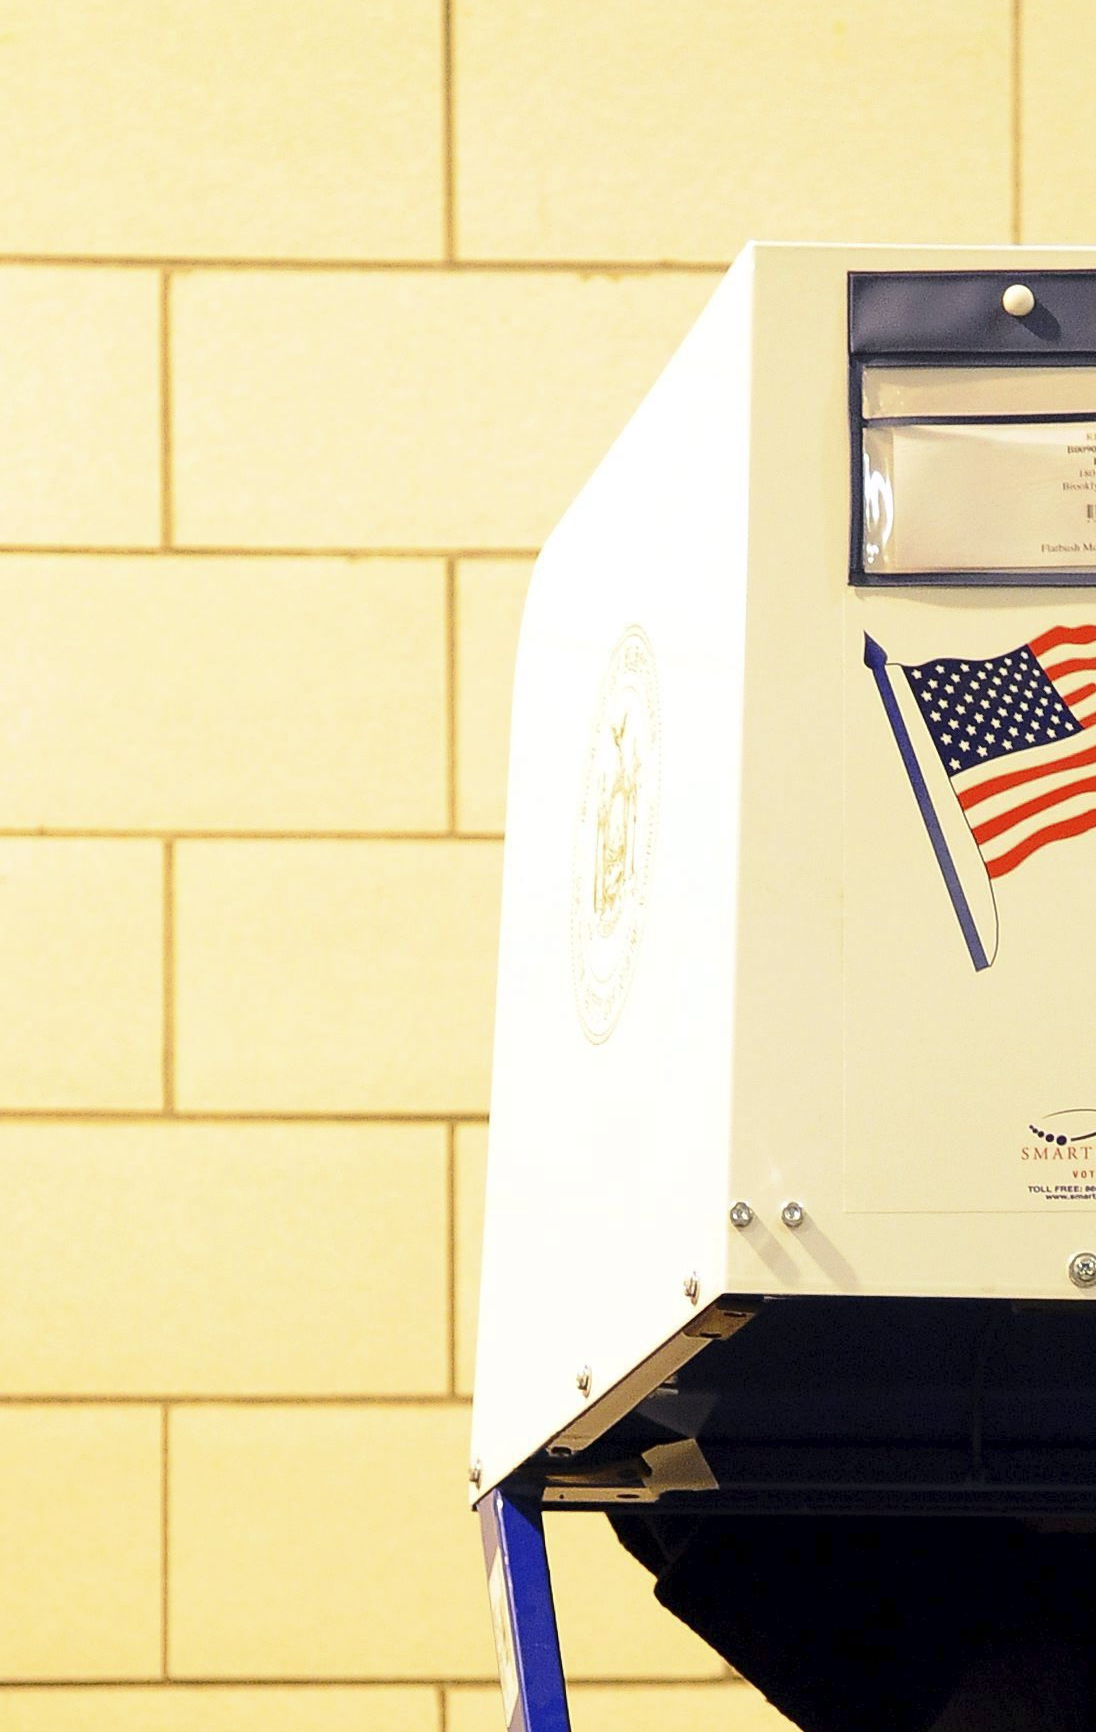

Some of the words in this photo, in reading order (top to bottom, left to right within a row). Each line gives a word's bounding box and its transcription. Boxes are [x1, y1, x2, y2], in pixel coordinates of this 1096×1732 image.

[1041, 543, 1080, 553] Flatbush
[1028, 1185, 1051, 1193] TOLL
[1054, 1185, 1083, 1193] FREE:
